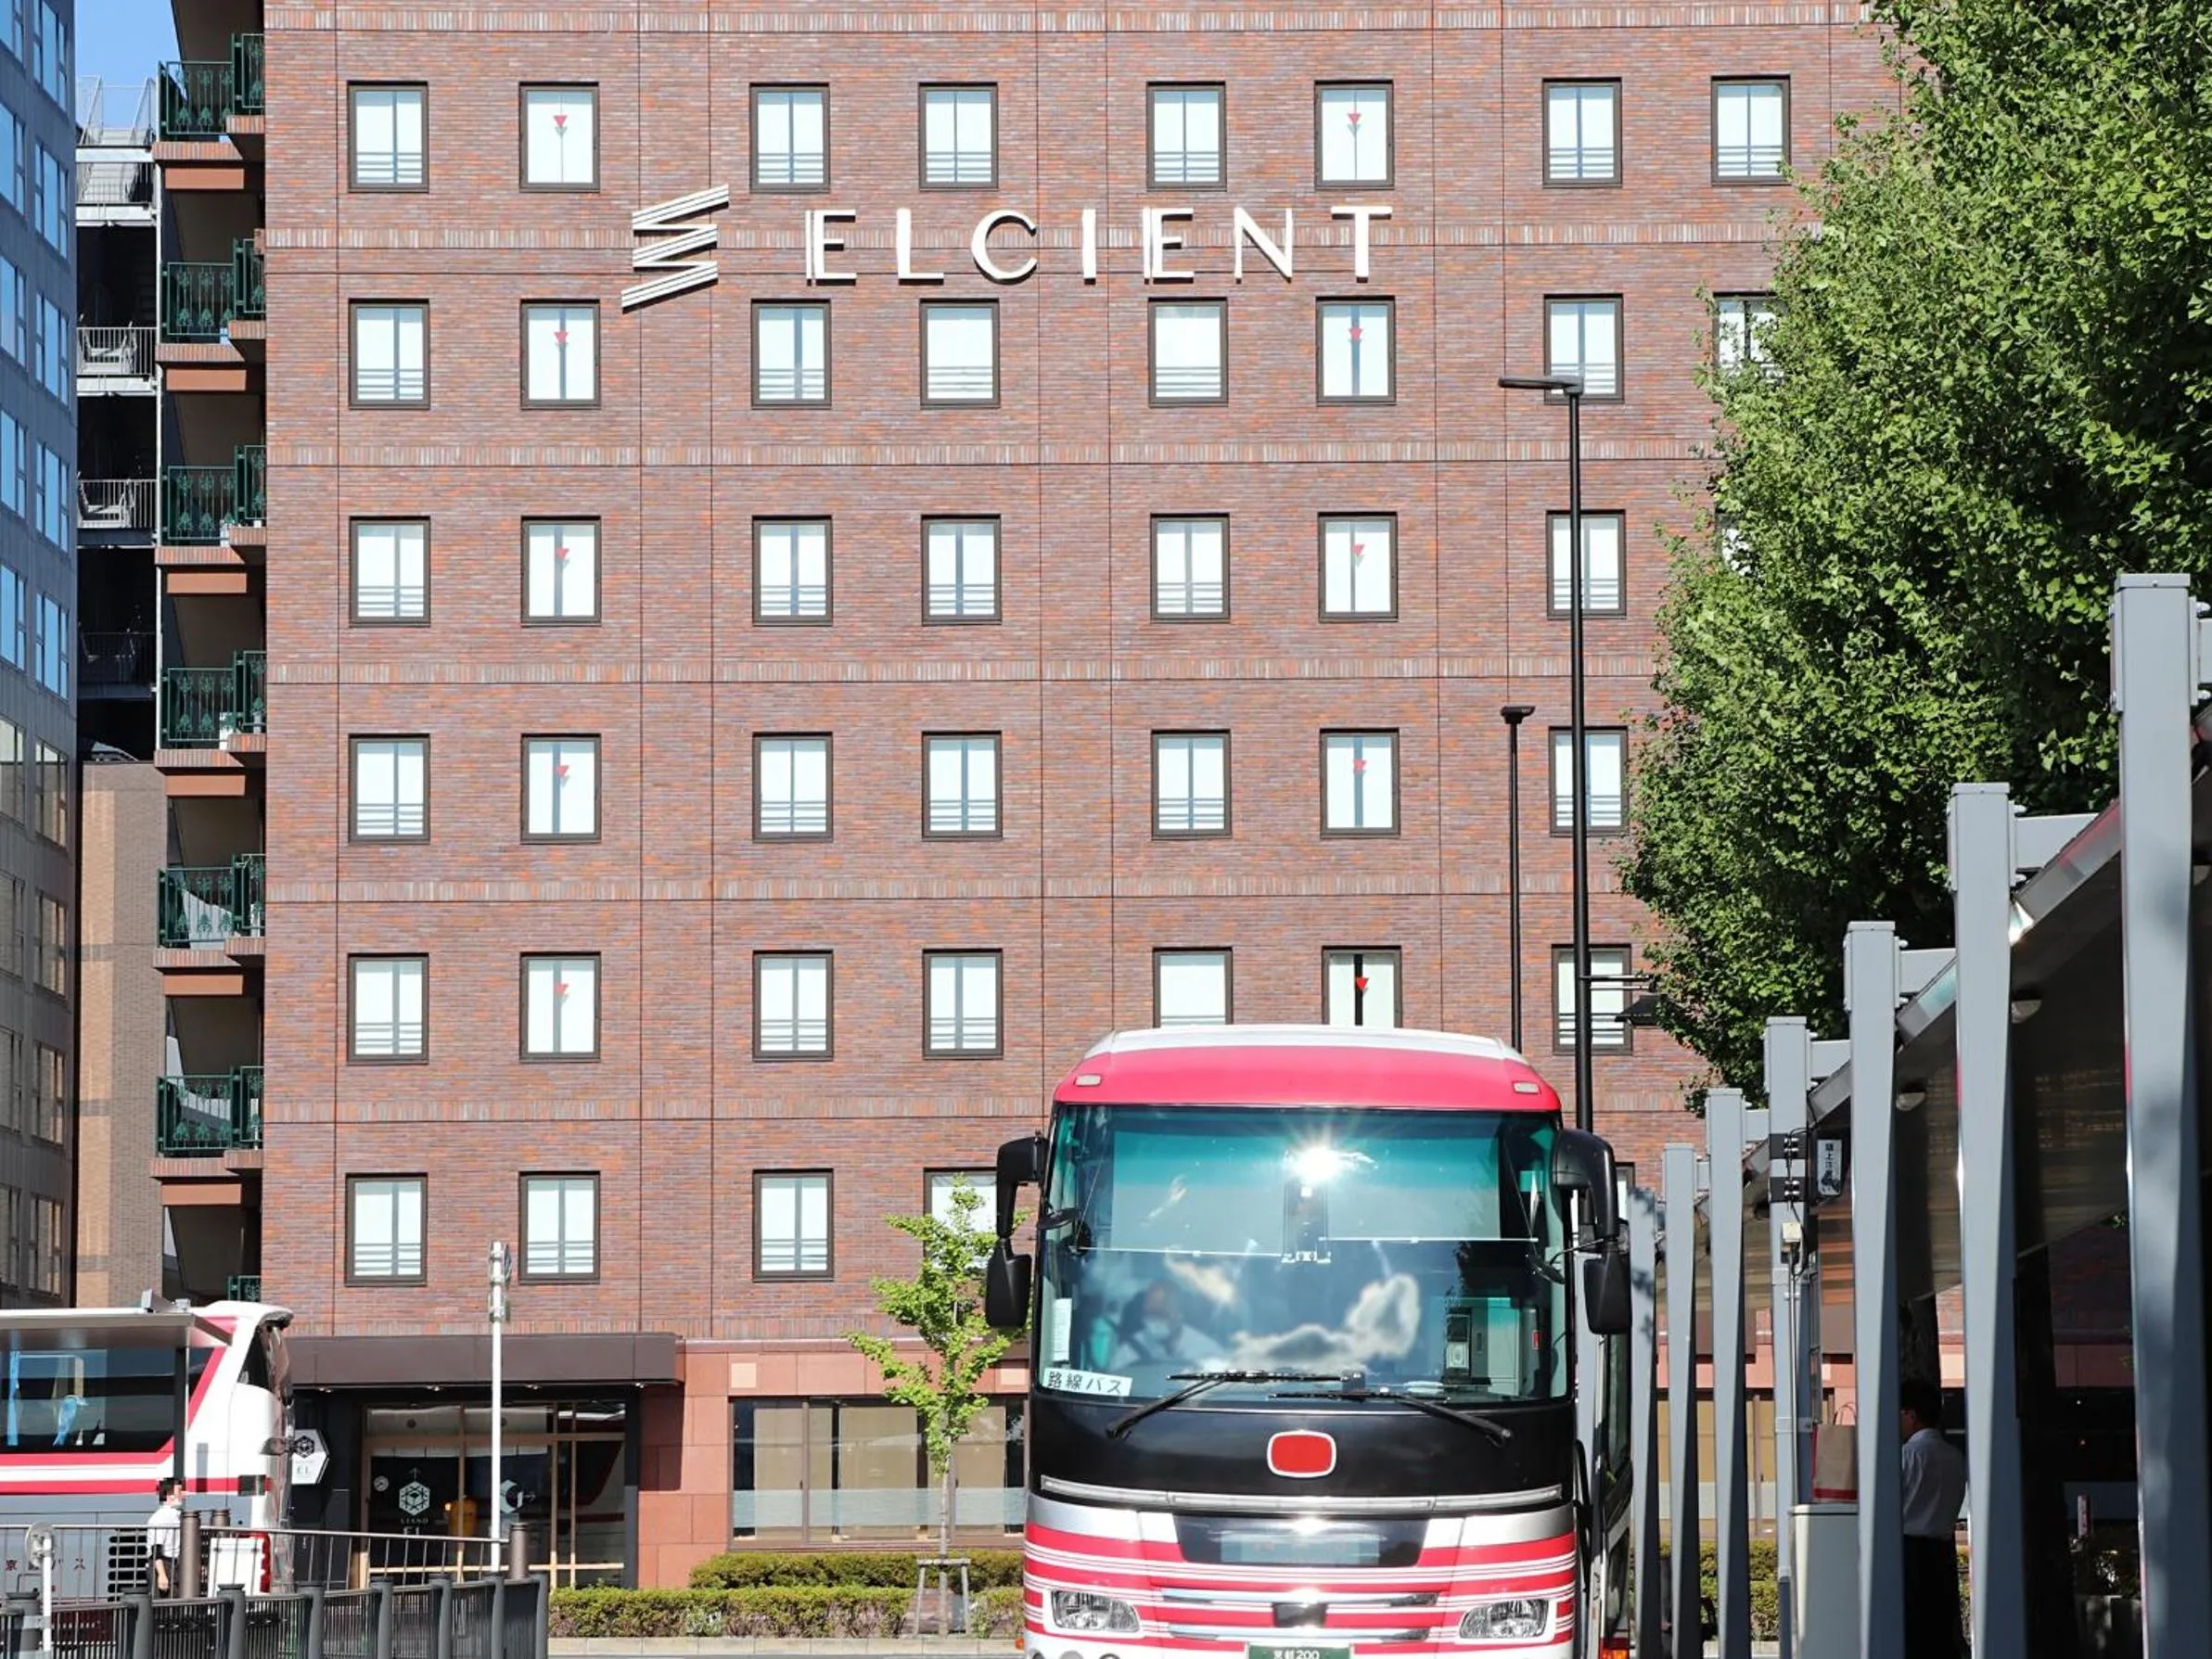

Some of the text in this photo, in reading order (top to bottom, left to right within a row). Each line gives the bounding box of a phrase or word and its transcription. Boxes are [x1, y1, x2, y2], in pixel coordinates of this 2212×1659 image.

[805, 206, 1393, 283] ELCIENT
[1047, 1372, 1121, 1394] 路線バス
